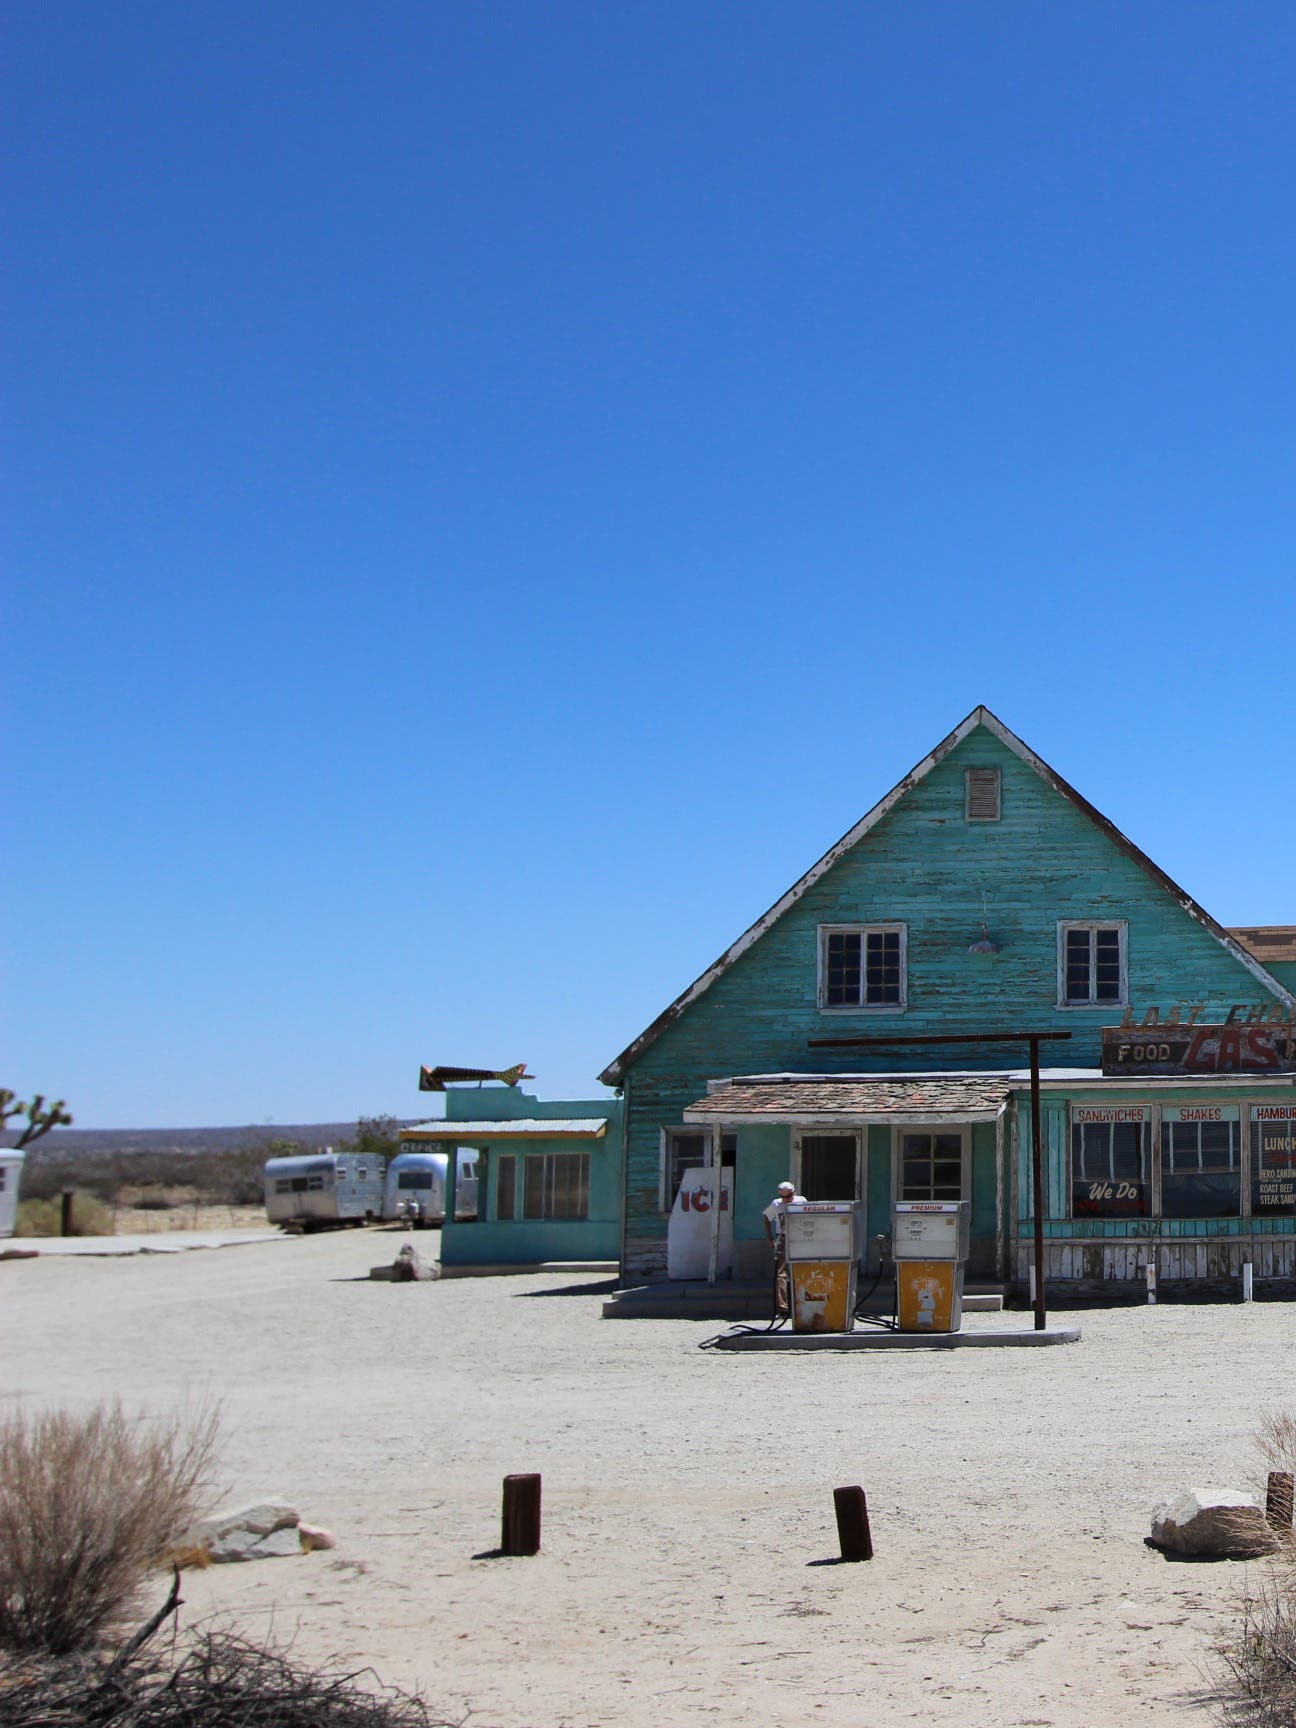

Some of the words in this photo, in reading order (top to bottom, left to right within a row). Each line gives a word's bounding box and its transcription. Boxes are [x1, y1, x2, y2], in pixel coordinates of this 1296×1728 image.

[1120, 1006, 1206, 1027] LAST
[1118, 1045, 1171, 1062] FOOD
[1184, 1028, 1279, 1069] GAS
[1078, 1109, 1144, 1123] SANDWICHES
[1179, 1108, 1222, 1121] SHAKES
[1259, 1169, 1275, 1179] HERO
[1089, 1182, 1113, 1200] We
[1116, 1181, 1137, 1199] Do
[1259, 1184, 1279, 1194] ROAST
[1279, 1183, 1294, 1193] BEEF
[1259, 1194, 1280, 1205] STEAK
